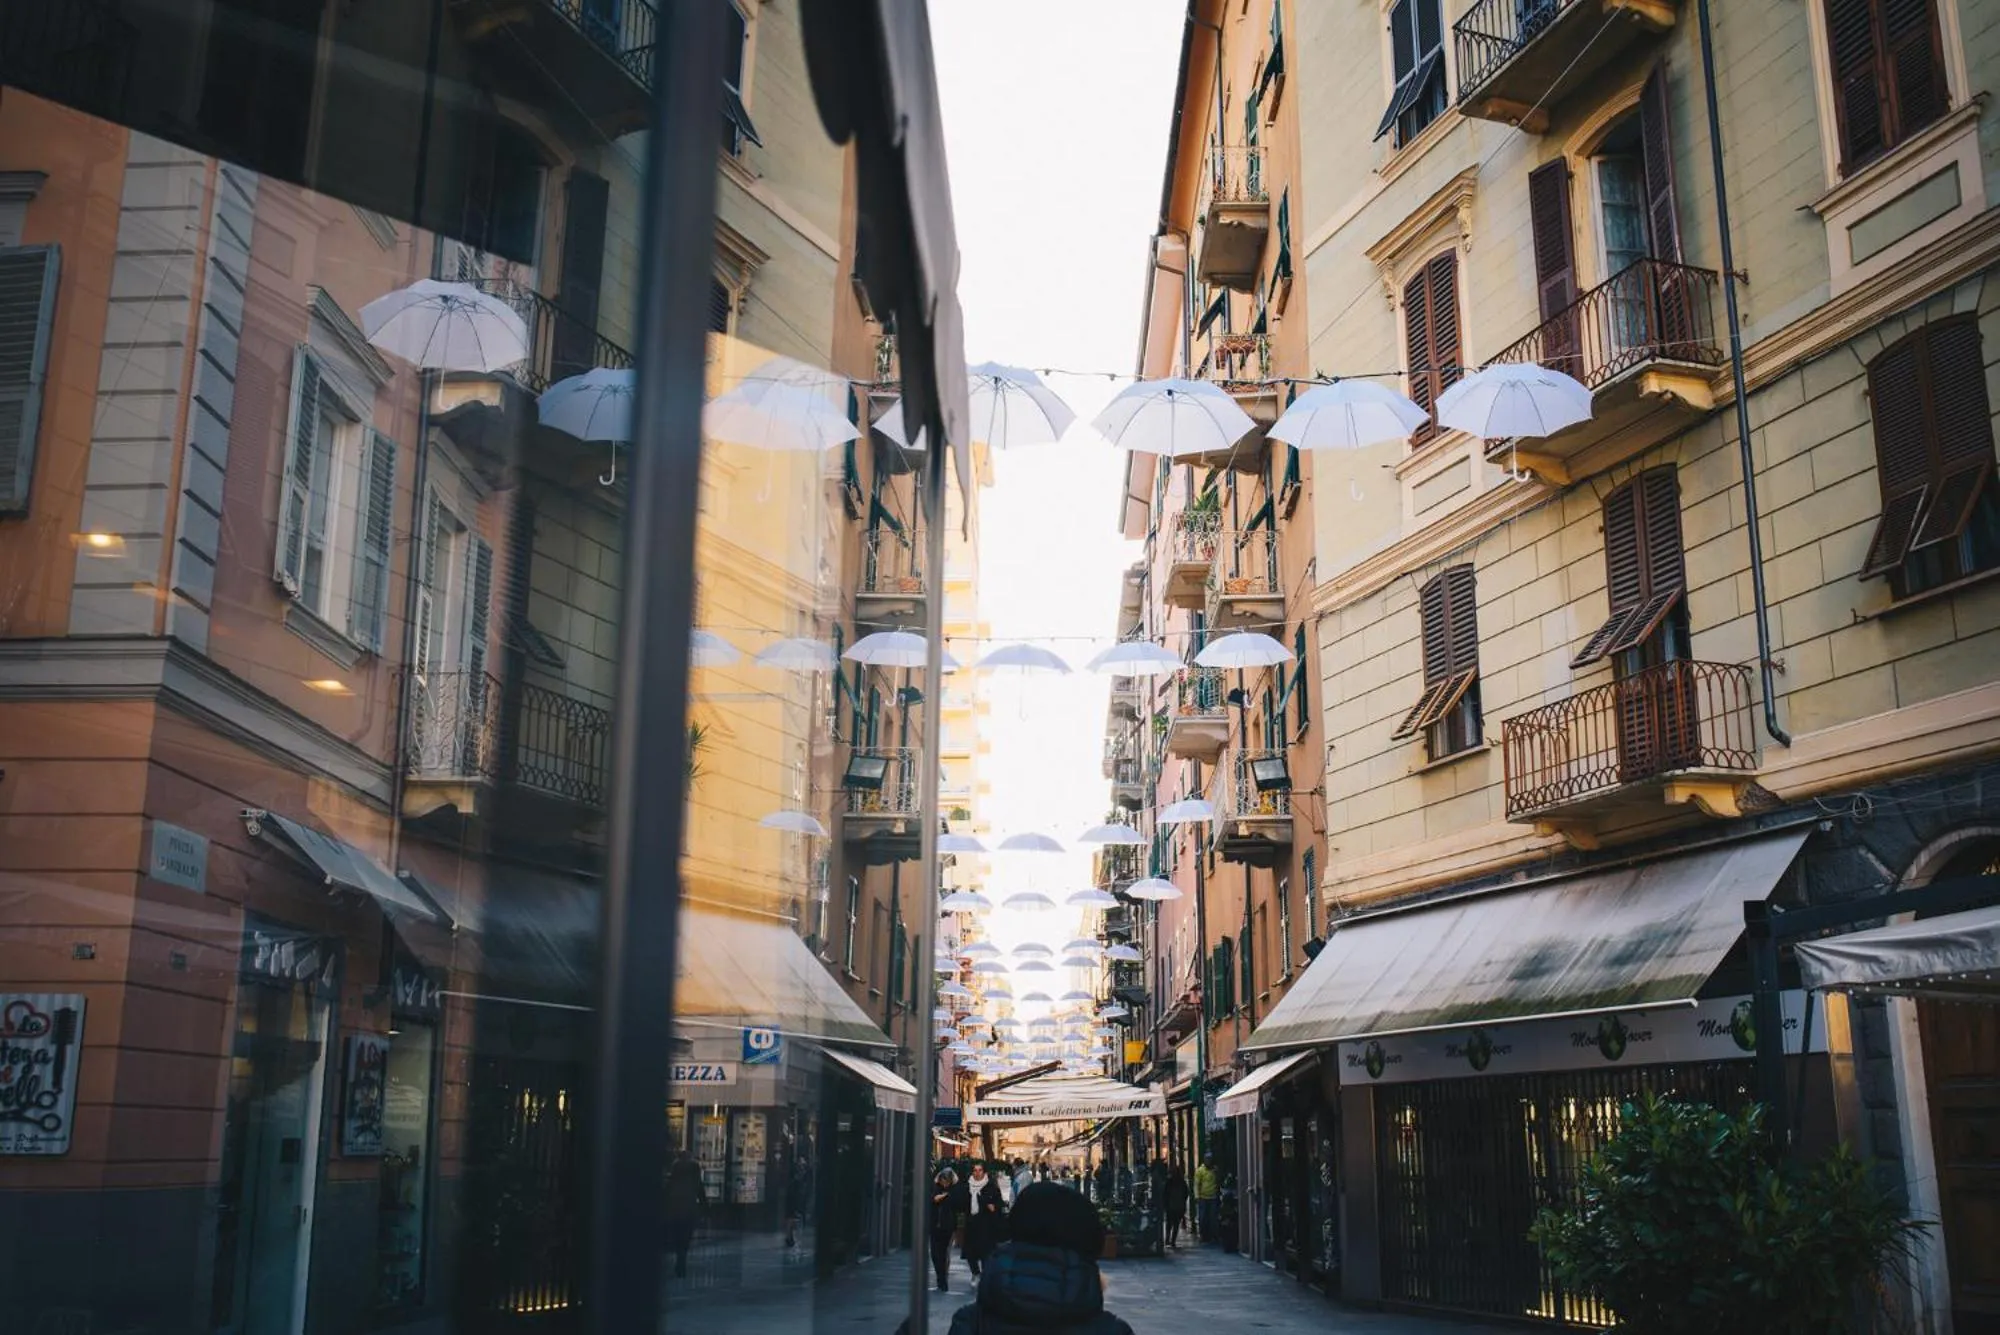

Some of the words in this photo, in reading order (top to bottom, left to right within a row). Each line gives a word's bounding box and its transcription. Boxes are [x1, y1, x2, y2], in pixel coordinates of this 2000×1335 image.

[0, 1040, 53, 1076] tega
[674, 1066, 726, 1081] EZZA
[977, 1105, 1034, 1116] INTERNET
[1040, 1105, 1093, 1118] Caffetteria
[1096, 1103, 1123, 1113] Italia
[1128, 1100, 1152, 1110] FAX
